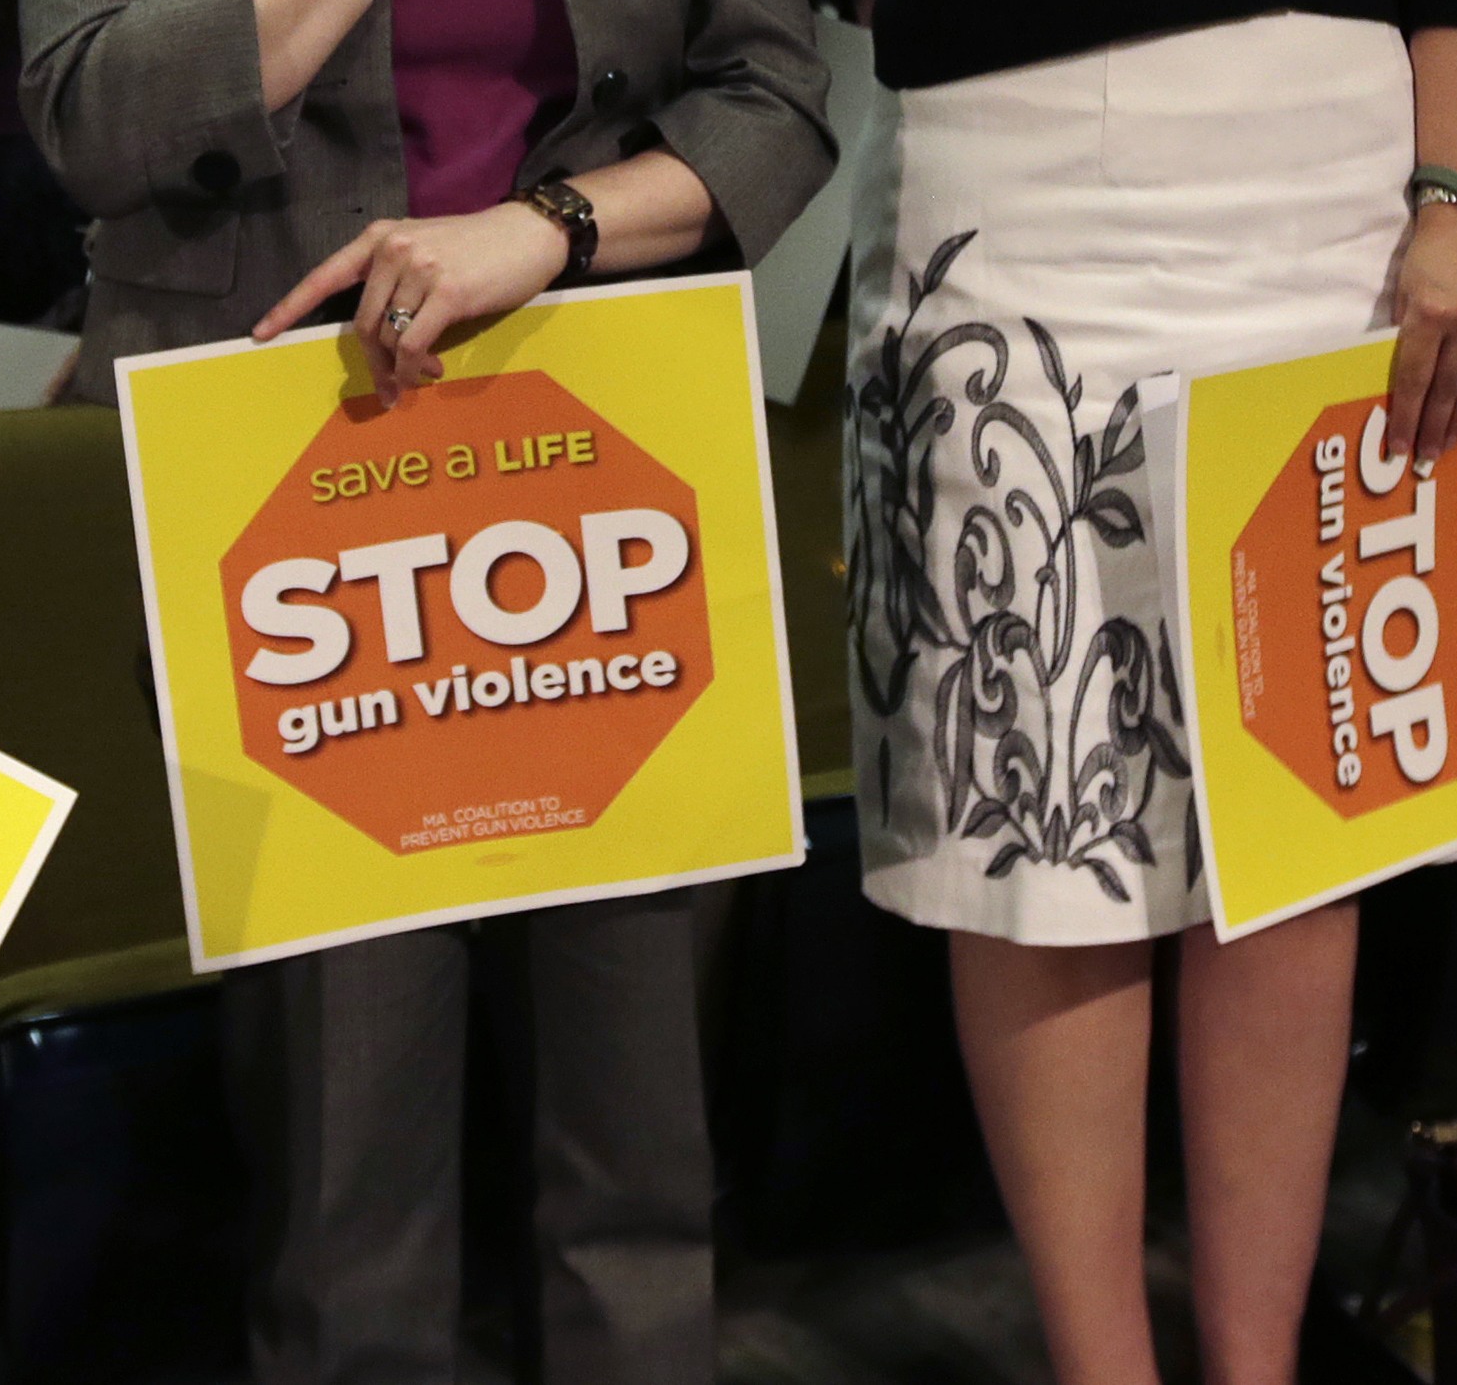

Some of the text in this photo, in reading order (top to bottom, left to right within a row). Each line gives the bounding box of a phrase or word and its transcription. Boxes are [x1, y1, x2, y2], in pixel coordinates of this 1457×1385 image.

[310, 429, 594, 503] save a LIFE
[240, 508, 689, 686] STOP
[1315, 434, 1361, 788] gun violence
[1360, 405, 1449, 783] STOP
[278, 649, 676, 753] gun violence
[400, 809, 586, 849] PREVENT GUN VIOLENCE
[422, 797, 561, 829] MA COALITION TO
